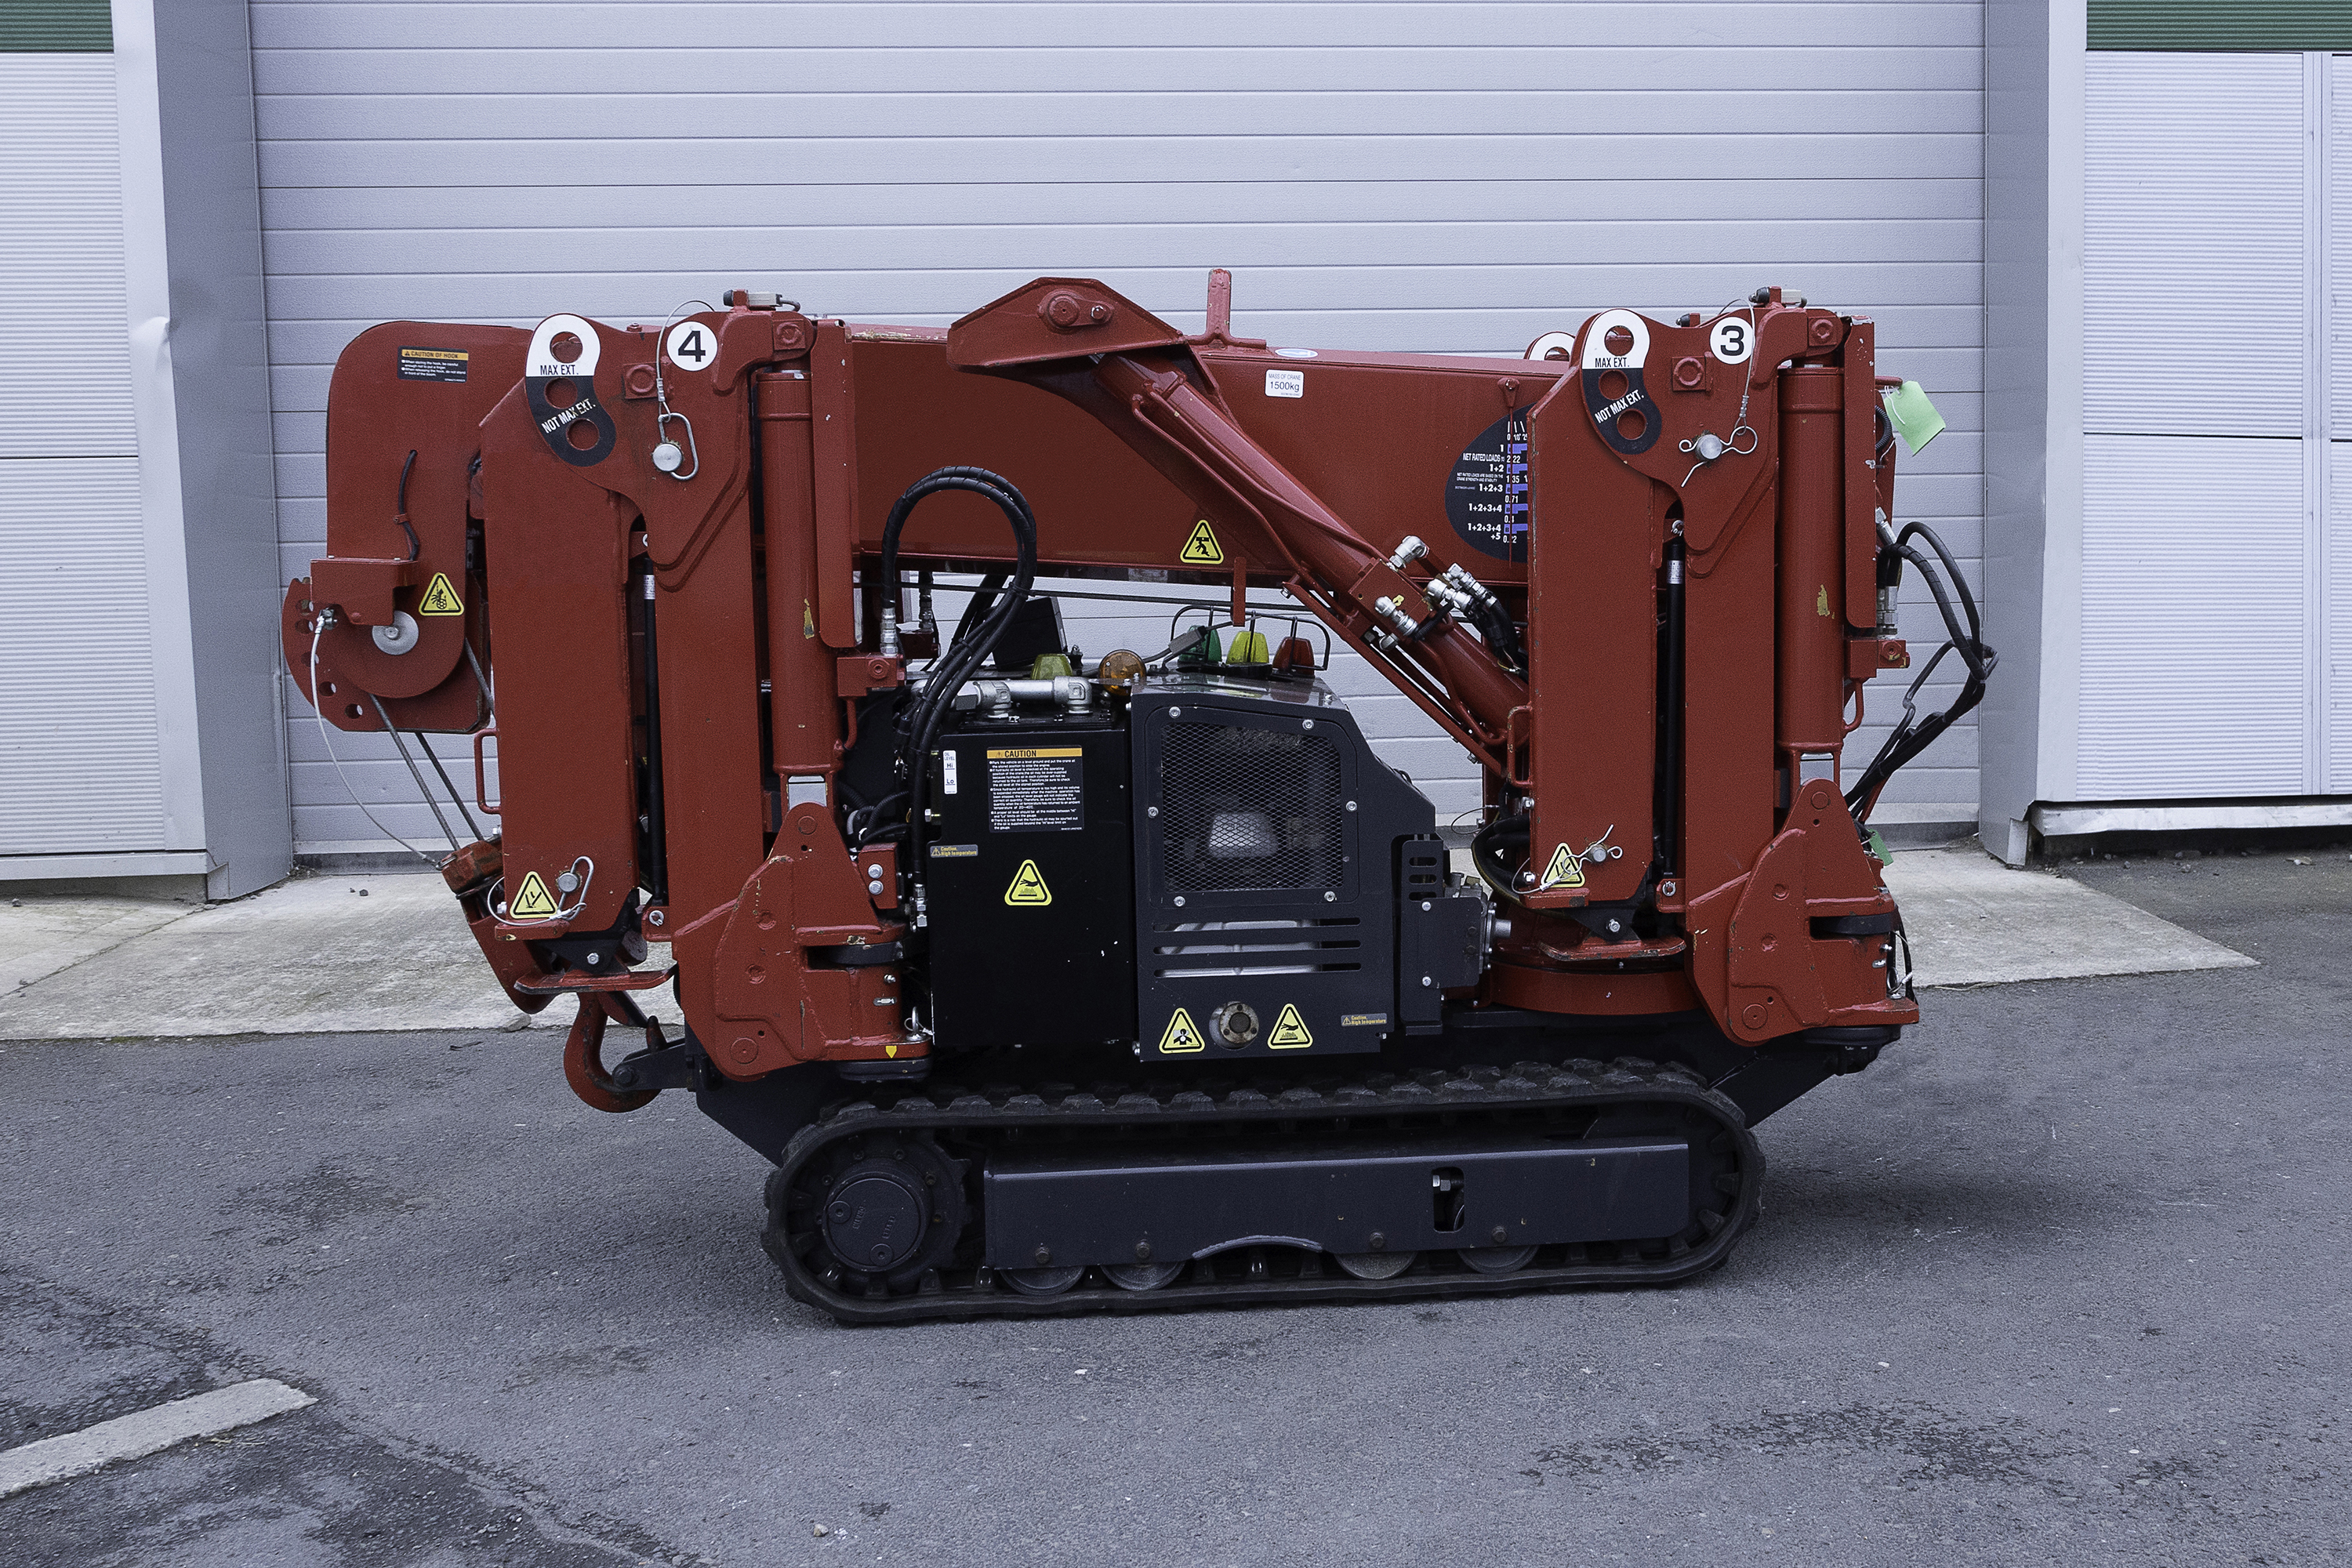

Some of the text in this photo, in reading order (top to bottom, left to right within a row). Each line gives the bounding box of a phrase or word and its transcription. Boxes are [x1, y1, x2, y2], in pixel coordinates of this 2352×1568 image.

[1721, 325, 1744, 355] 3
[678, 331, 706, 362] 4
[1595, 358, 1629, 367] MAX EXT.
[540, 365, 579, 375] MAX EXT.
[1271, 382, 1299, 392] 1500kg
[1595, 390, 1644, 423] NOT MAX EXT.
[542, 398, 596, 434] NOT MAX EXT.
[1479, 484, 1503, 492] 1+2+3
[1468, 503, 1501, 512] 1+2+3+4
[1468, 523, 1501, 532] 1+2+3+4
